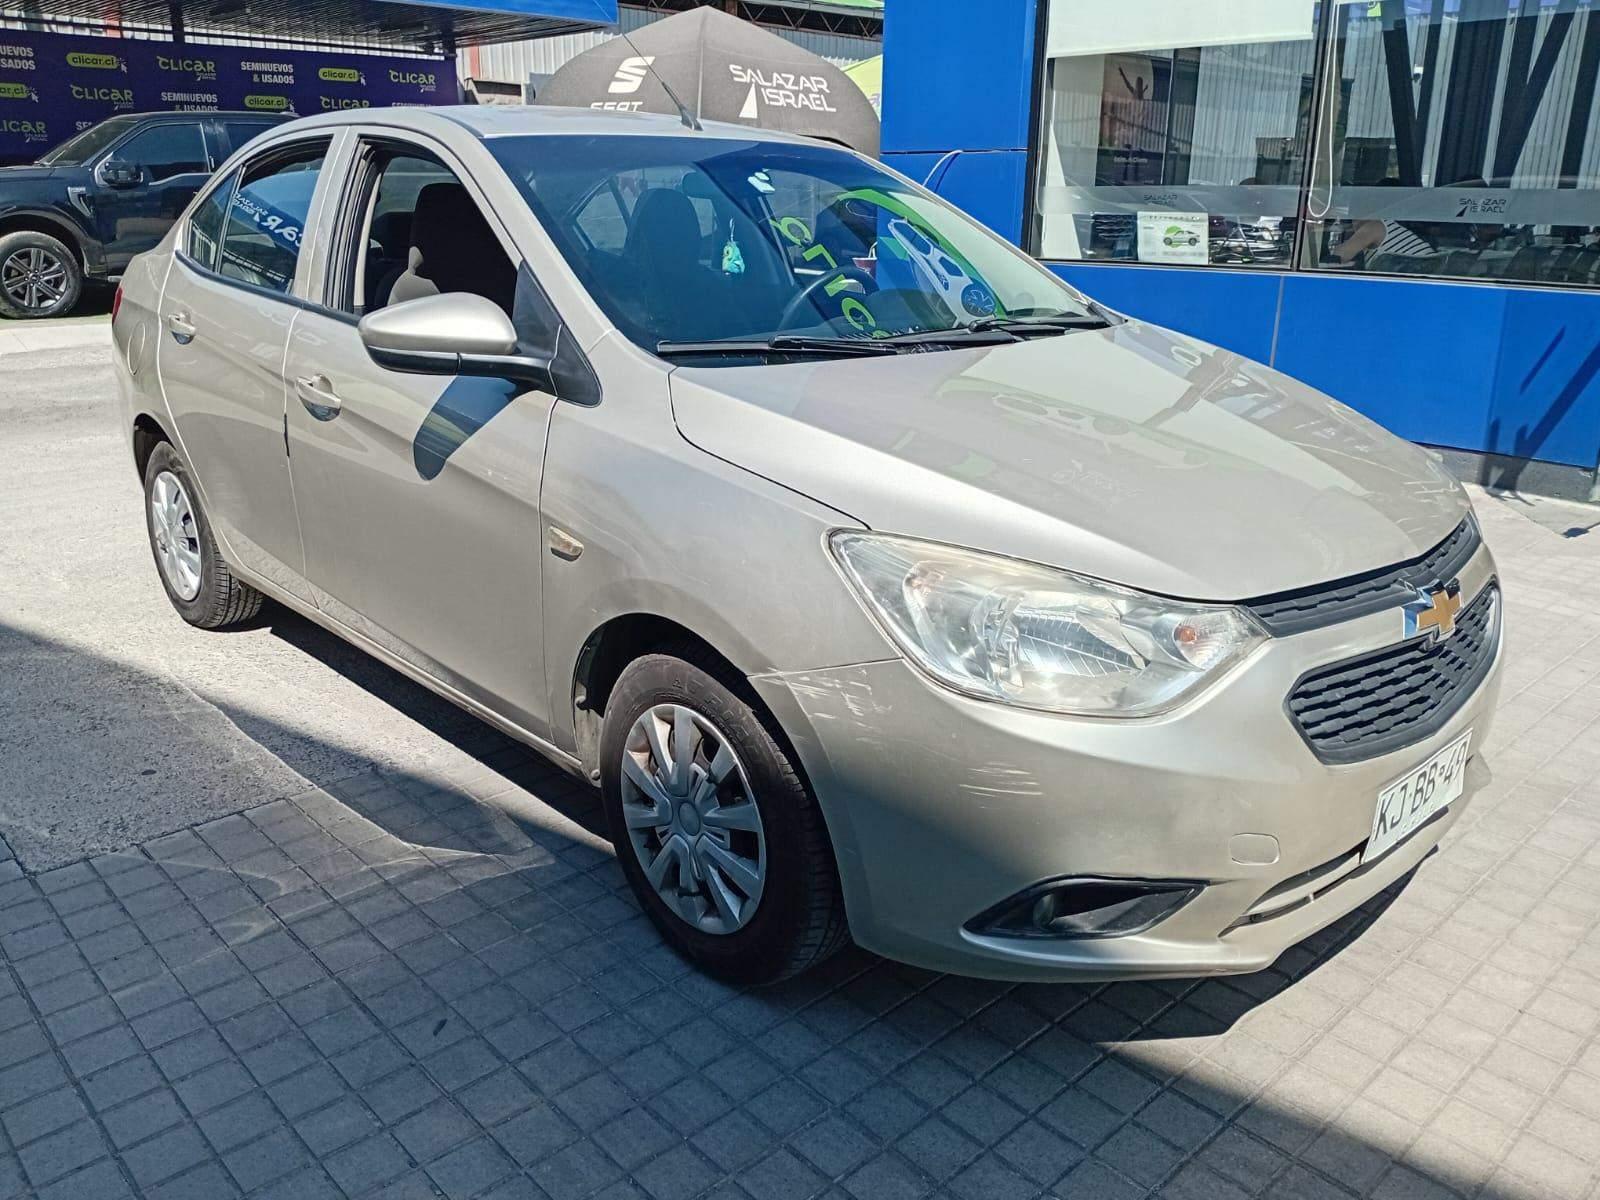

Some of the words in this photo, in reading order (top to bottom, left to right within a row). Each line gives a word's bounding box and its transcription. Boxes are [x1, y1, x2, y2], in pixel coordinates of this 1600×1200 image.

[72, 55, 115, 65] clicar.cl
[240, 61, 294, 73] SEMINUEVOS
[261, 74, 295, 84] USADOS
[321, 70, 357, 80] clicar.cl
[728, 64, 831, 94] SALAZAR
[161, 91, 218, 103] SEMINUEVOS
[248, 97, 285, 106] clicar.cl
[761, 87, 837, 113] ISRAEL
